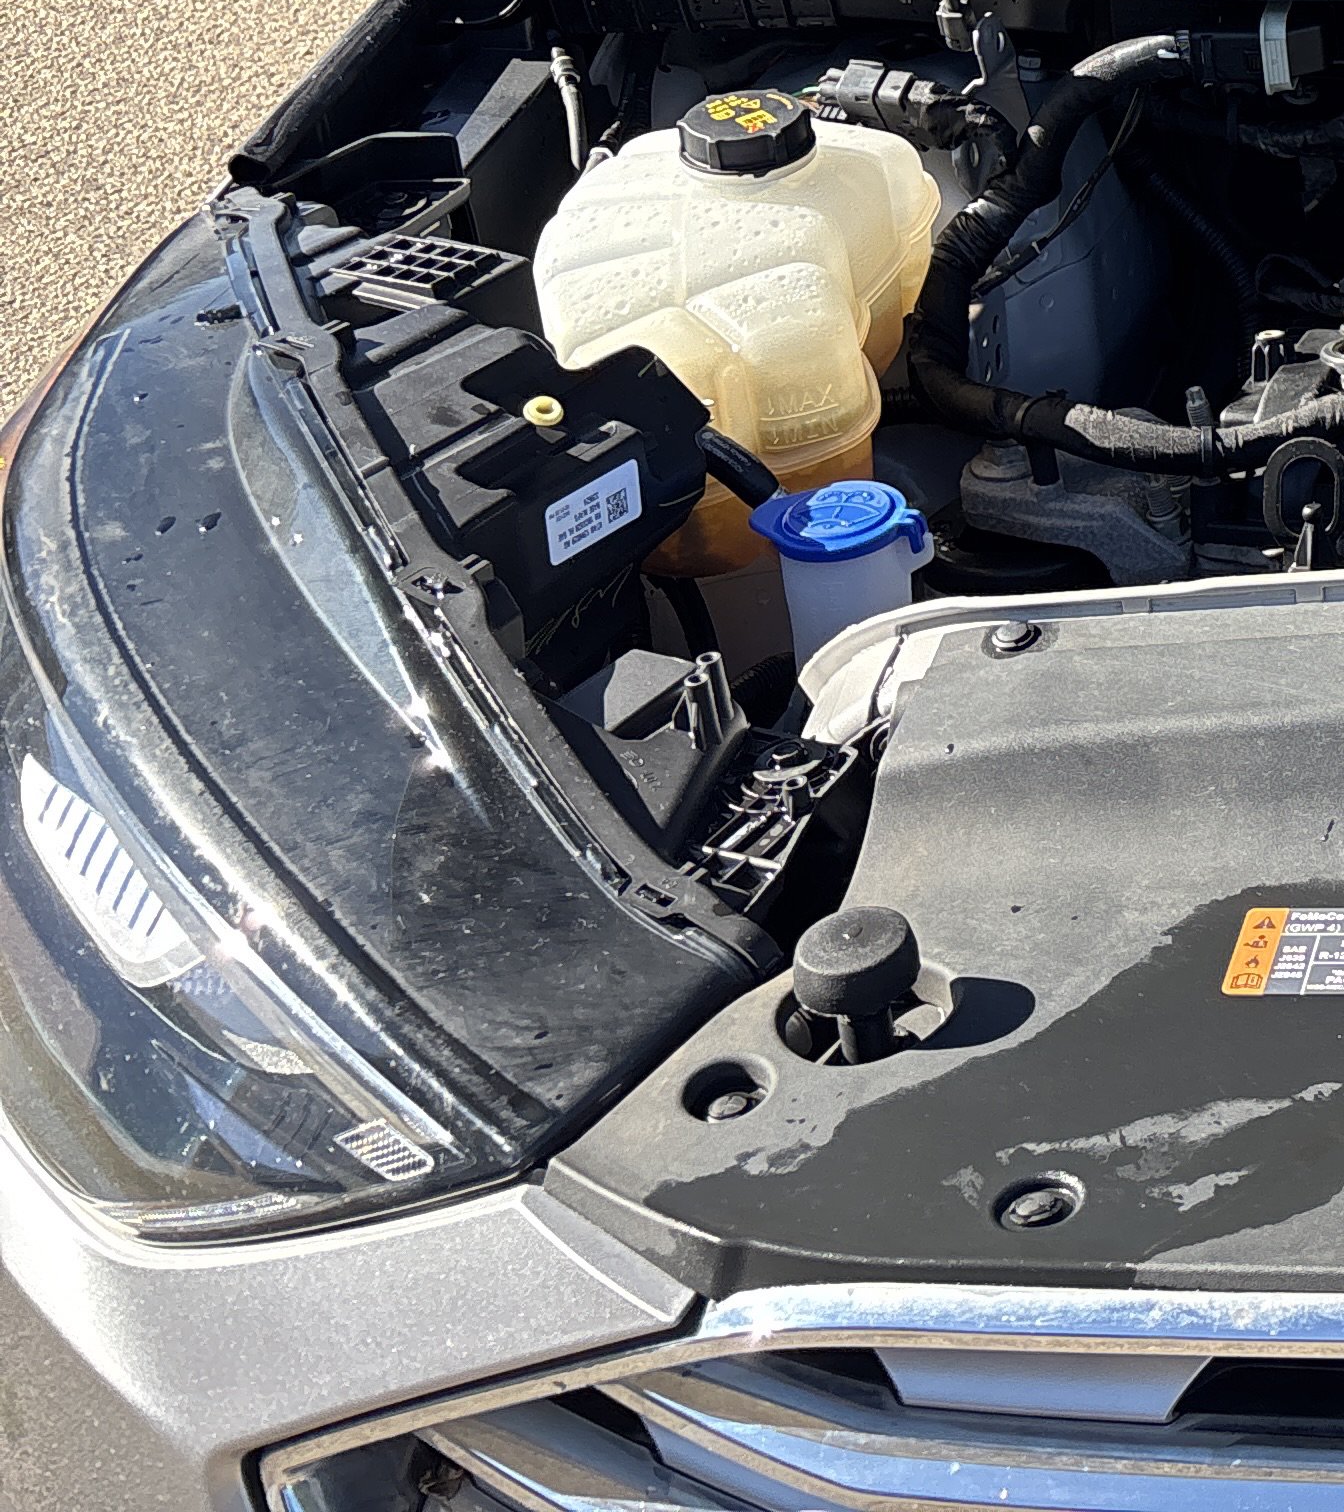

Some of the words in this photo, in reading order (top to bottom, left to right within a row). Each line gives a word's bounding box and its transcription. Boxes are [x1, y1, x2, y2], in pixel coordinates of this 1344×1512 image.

[779, 383, 835, 414] MAX
[783, 412, 838, 445] MIN
[1291, 912, 1344, 921] FoMoCo
[1285, 924, 1325, 933] (GWP
[1326, 924, 1341, 933] 4)
